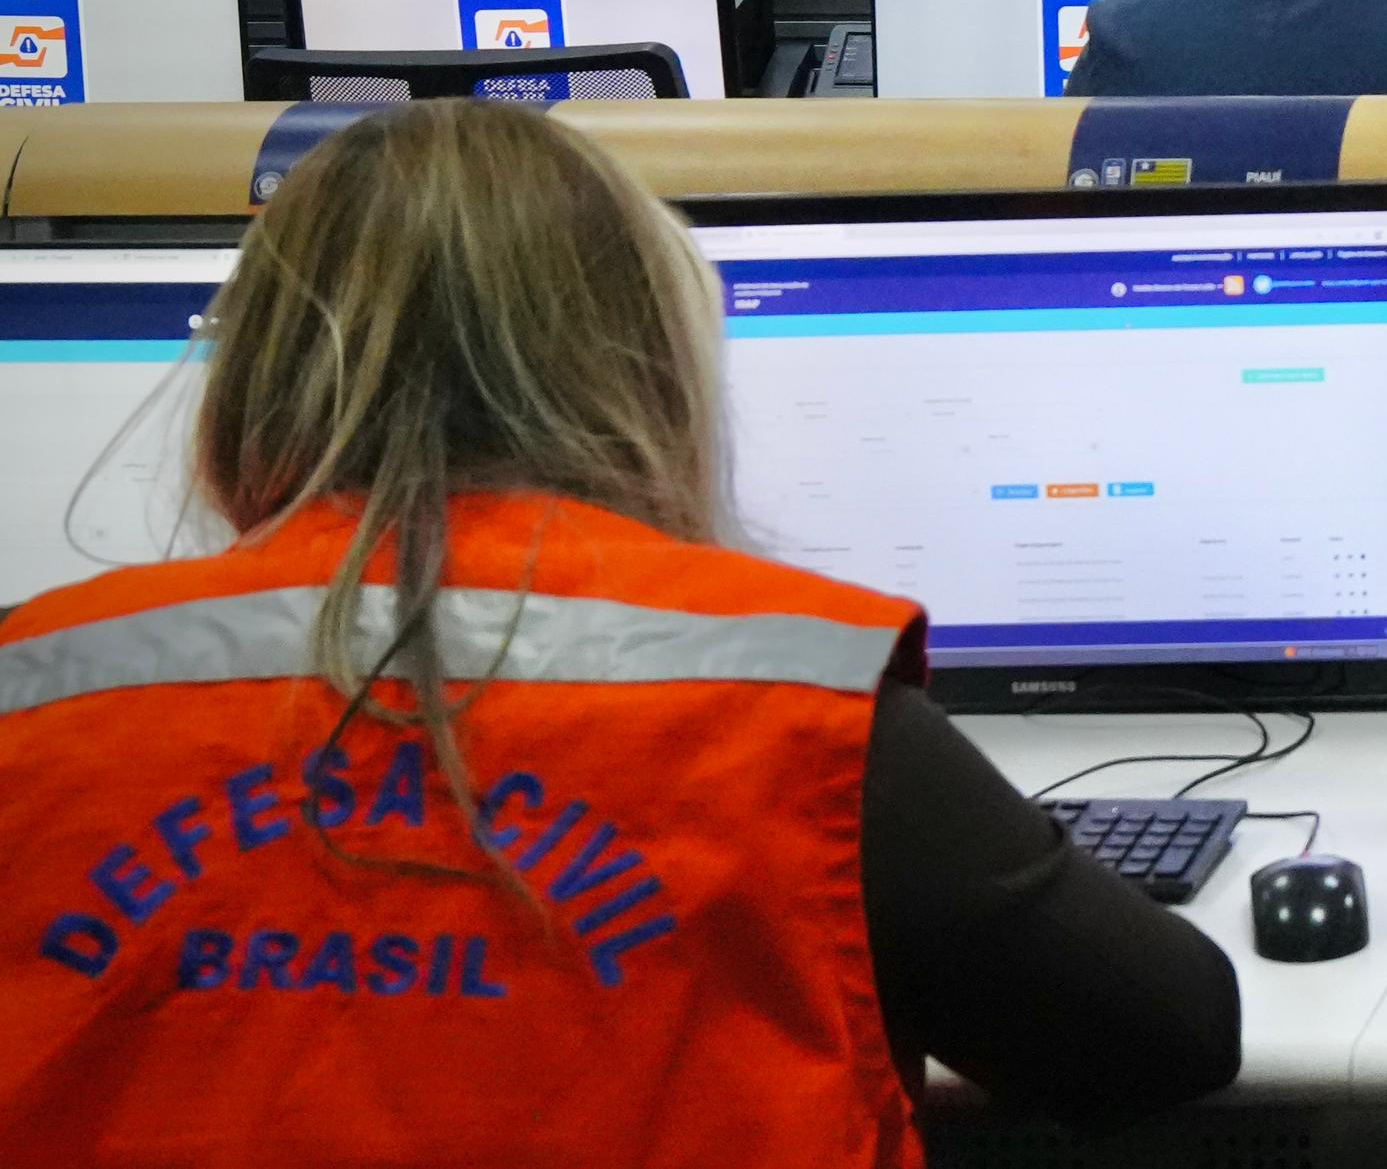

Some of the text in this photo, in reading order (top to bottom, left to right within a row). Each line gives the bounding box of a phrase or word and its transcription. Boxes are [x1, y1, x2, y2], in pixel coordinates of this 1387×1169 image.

[0, 84, 66, 98] DEFESA
[39, 741, 678, 987] DEFESA CIVIL
[177, 927, 509, 999] BRASIL
